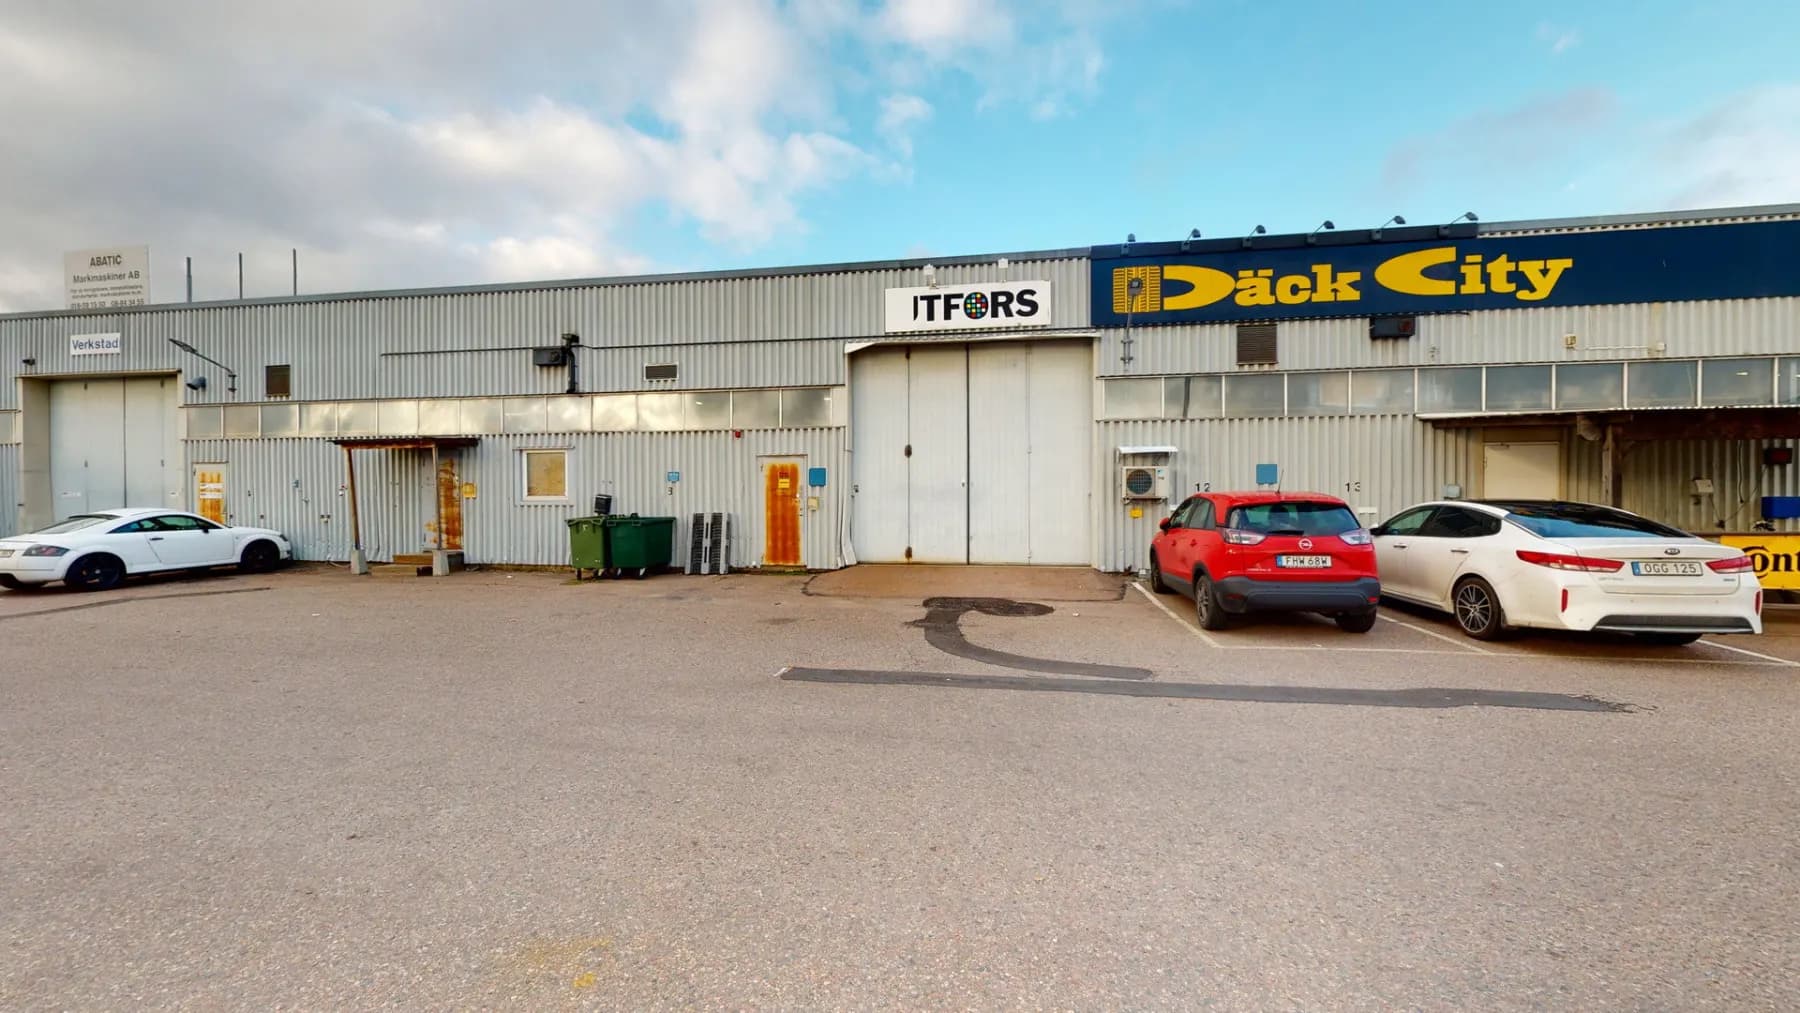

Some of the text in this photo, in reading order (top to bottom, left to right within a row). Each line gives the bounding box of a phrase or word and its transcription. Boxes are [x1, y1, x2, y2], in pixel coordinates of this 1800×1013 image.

[90, 255, 122, 266] ABATIC
[73, 270, 140, 283] Markmaskiner AB
[1163, 247, 1573, 311] Däck City
[72, 337, 119, 350] Verkstad
[1285, 557, 1305, 566] FHW
[1644, 563, 1697, 574] OGG 125
